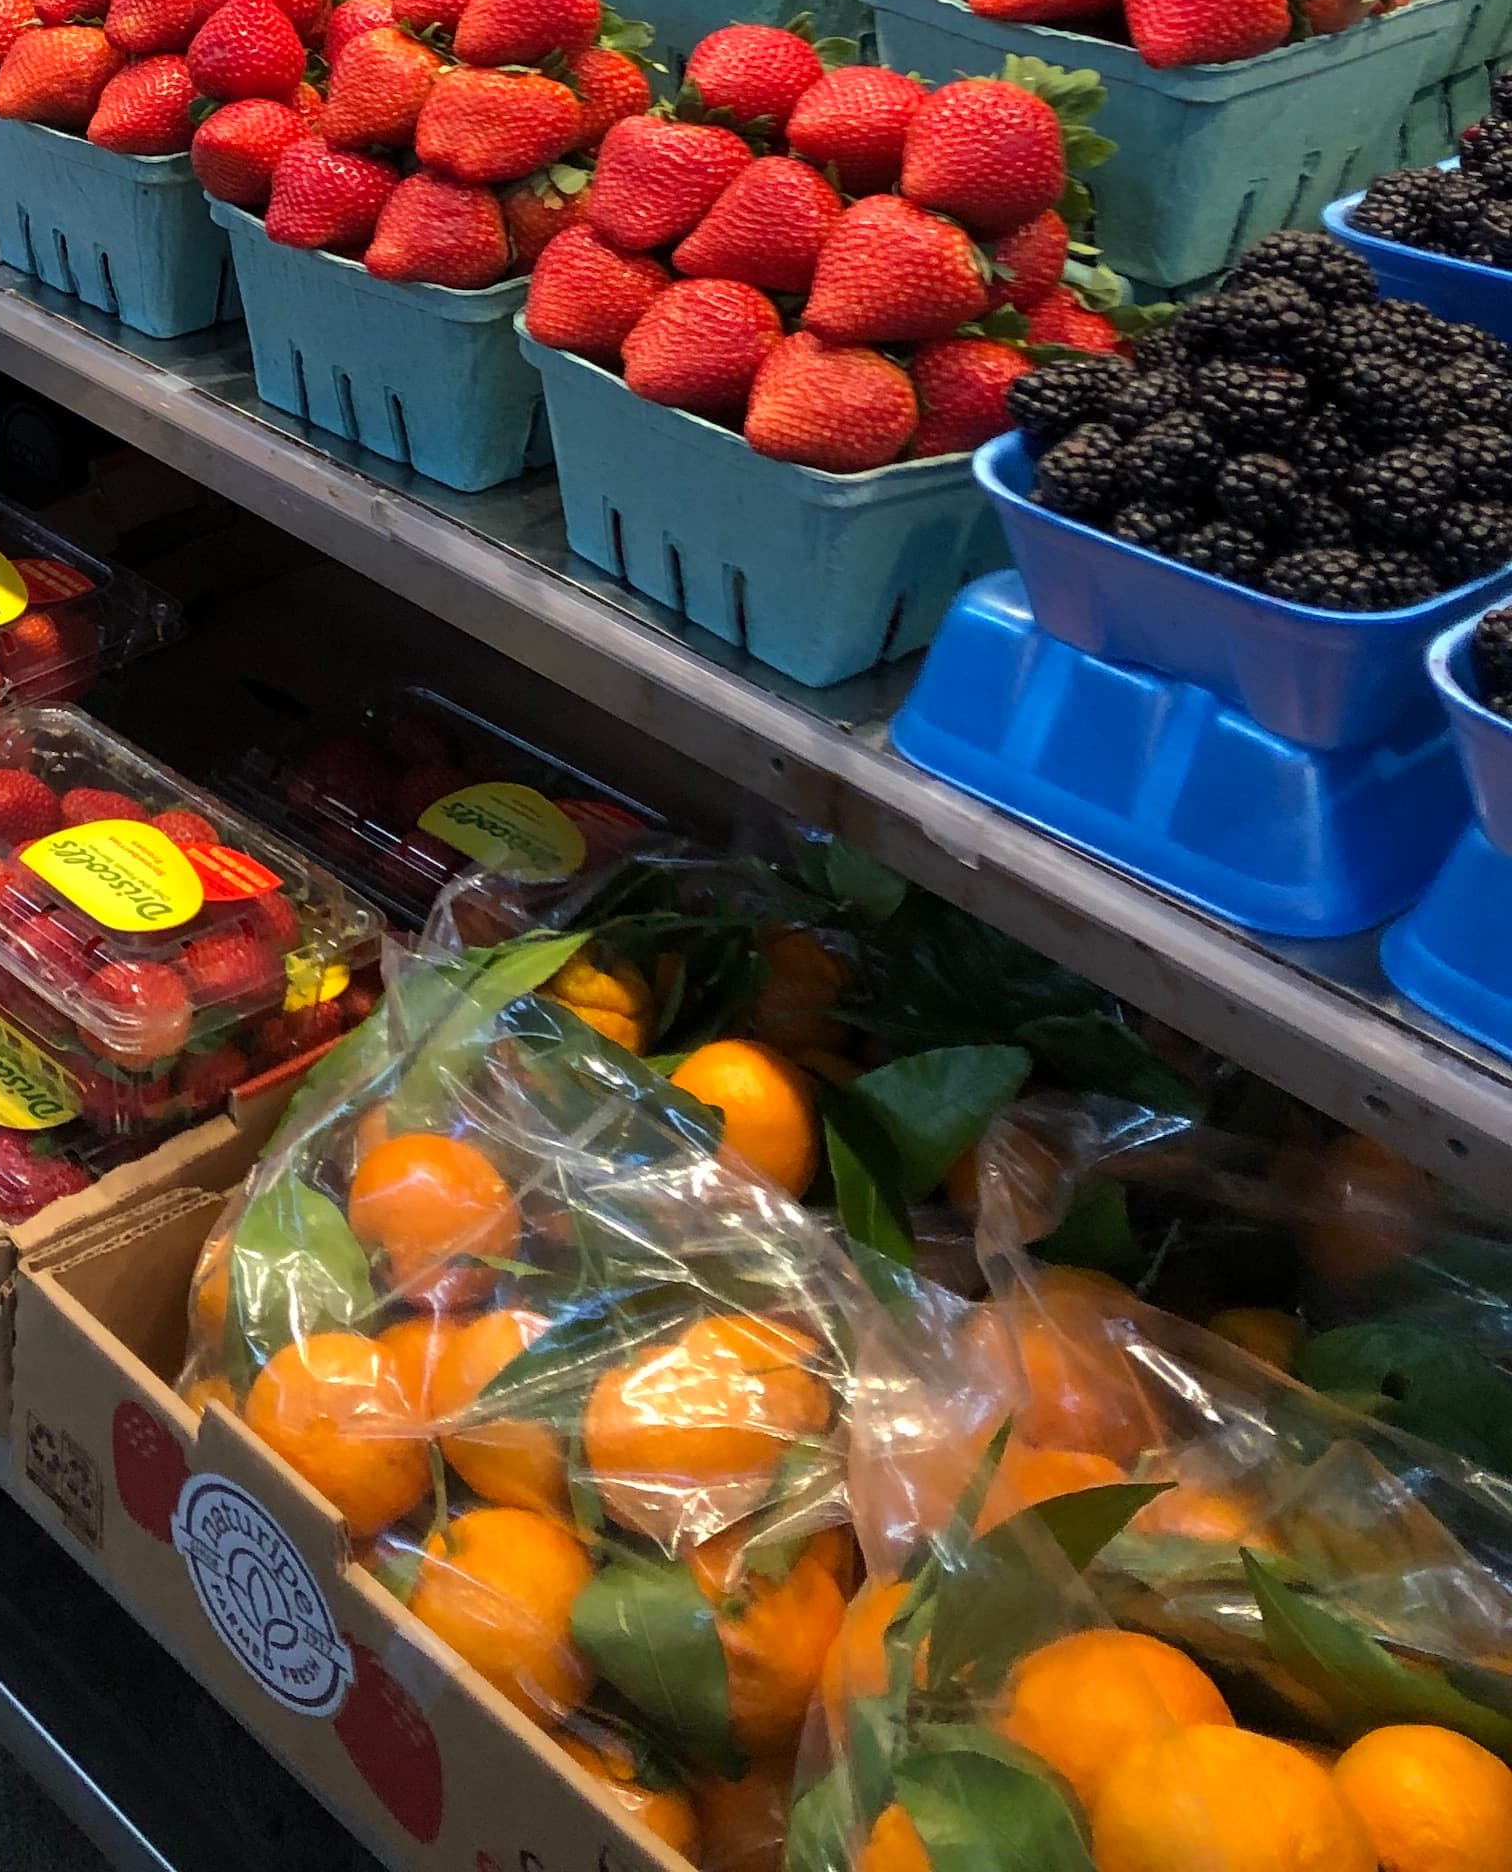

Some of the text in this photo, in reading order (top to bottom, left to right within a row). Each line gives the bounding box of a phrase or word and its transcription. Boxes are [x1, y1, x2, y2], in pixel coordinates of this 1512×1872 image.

[48, 839, 174, 922] Driscoll's
[210, 1582, 322, 1686] FARMED FRESH
